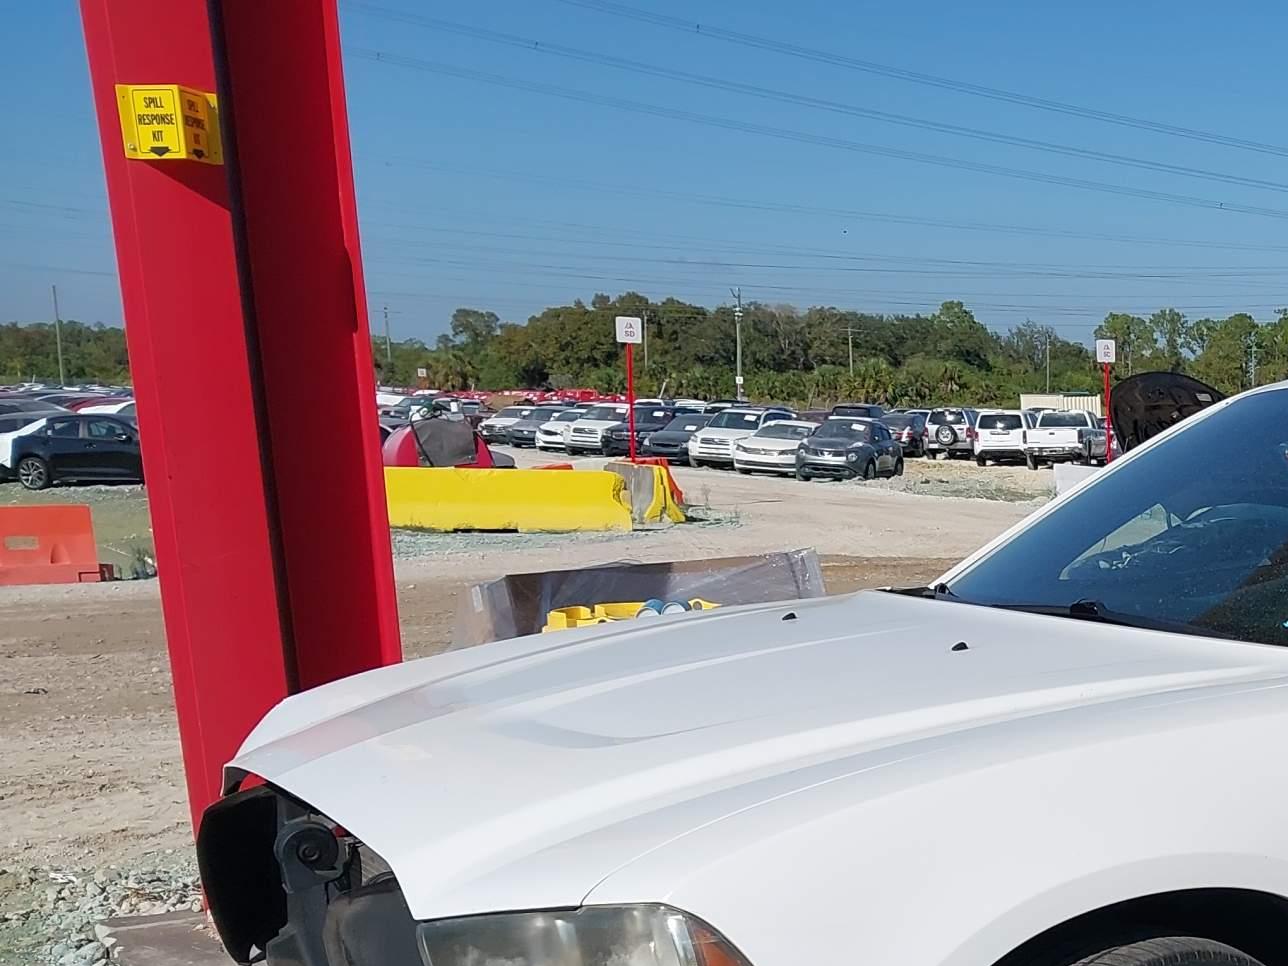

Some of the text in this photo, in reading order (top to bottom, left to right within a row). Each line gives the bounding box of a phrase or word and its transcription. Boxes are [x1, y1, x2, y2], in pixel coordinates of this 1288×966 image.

[143, 96, 164, 109] SPILL
[137, 113, 175, 126] RESPONSE
[151, 130, 164, 143] KIT
